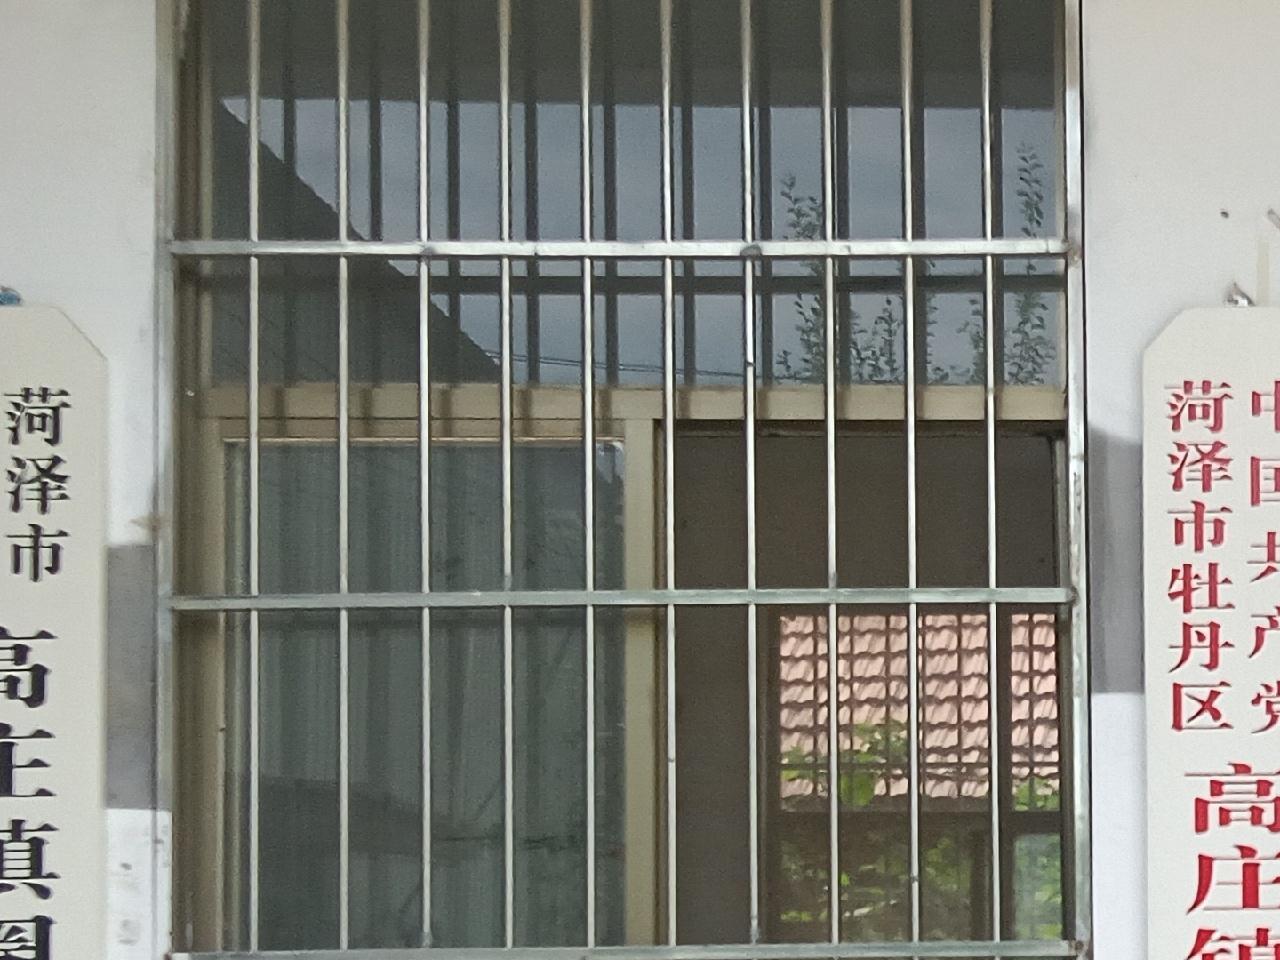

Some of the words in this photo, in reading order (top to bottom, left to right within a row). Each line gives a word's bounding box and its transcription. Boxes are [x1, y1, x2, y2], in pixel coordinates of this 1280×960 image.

[3, 386, 72, 583] 菏泽市
[1164, 379, 1236, 733] 菏泽市牡丹区
